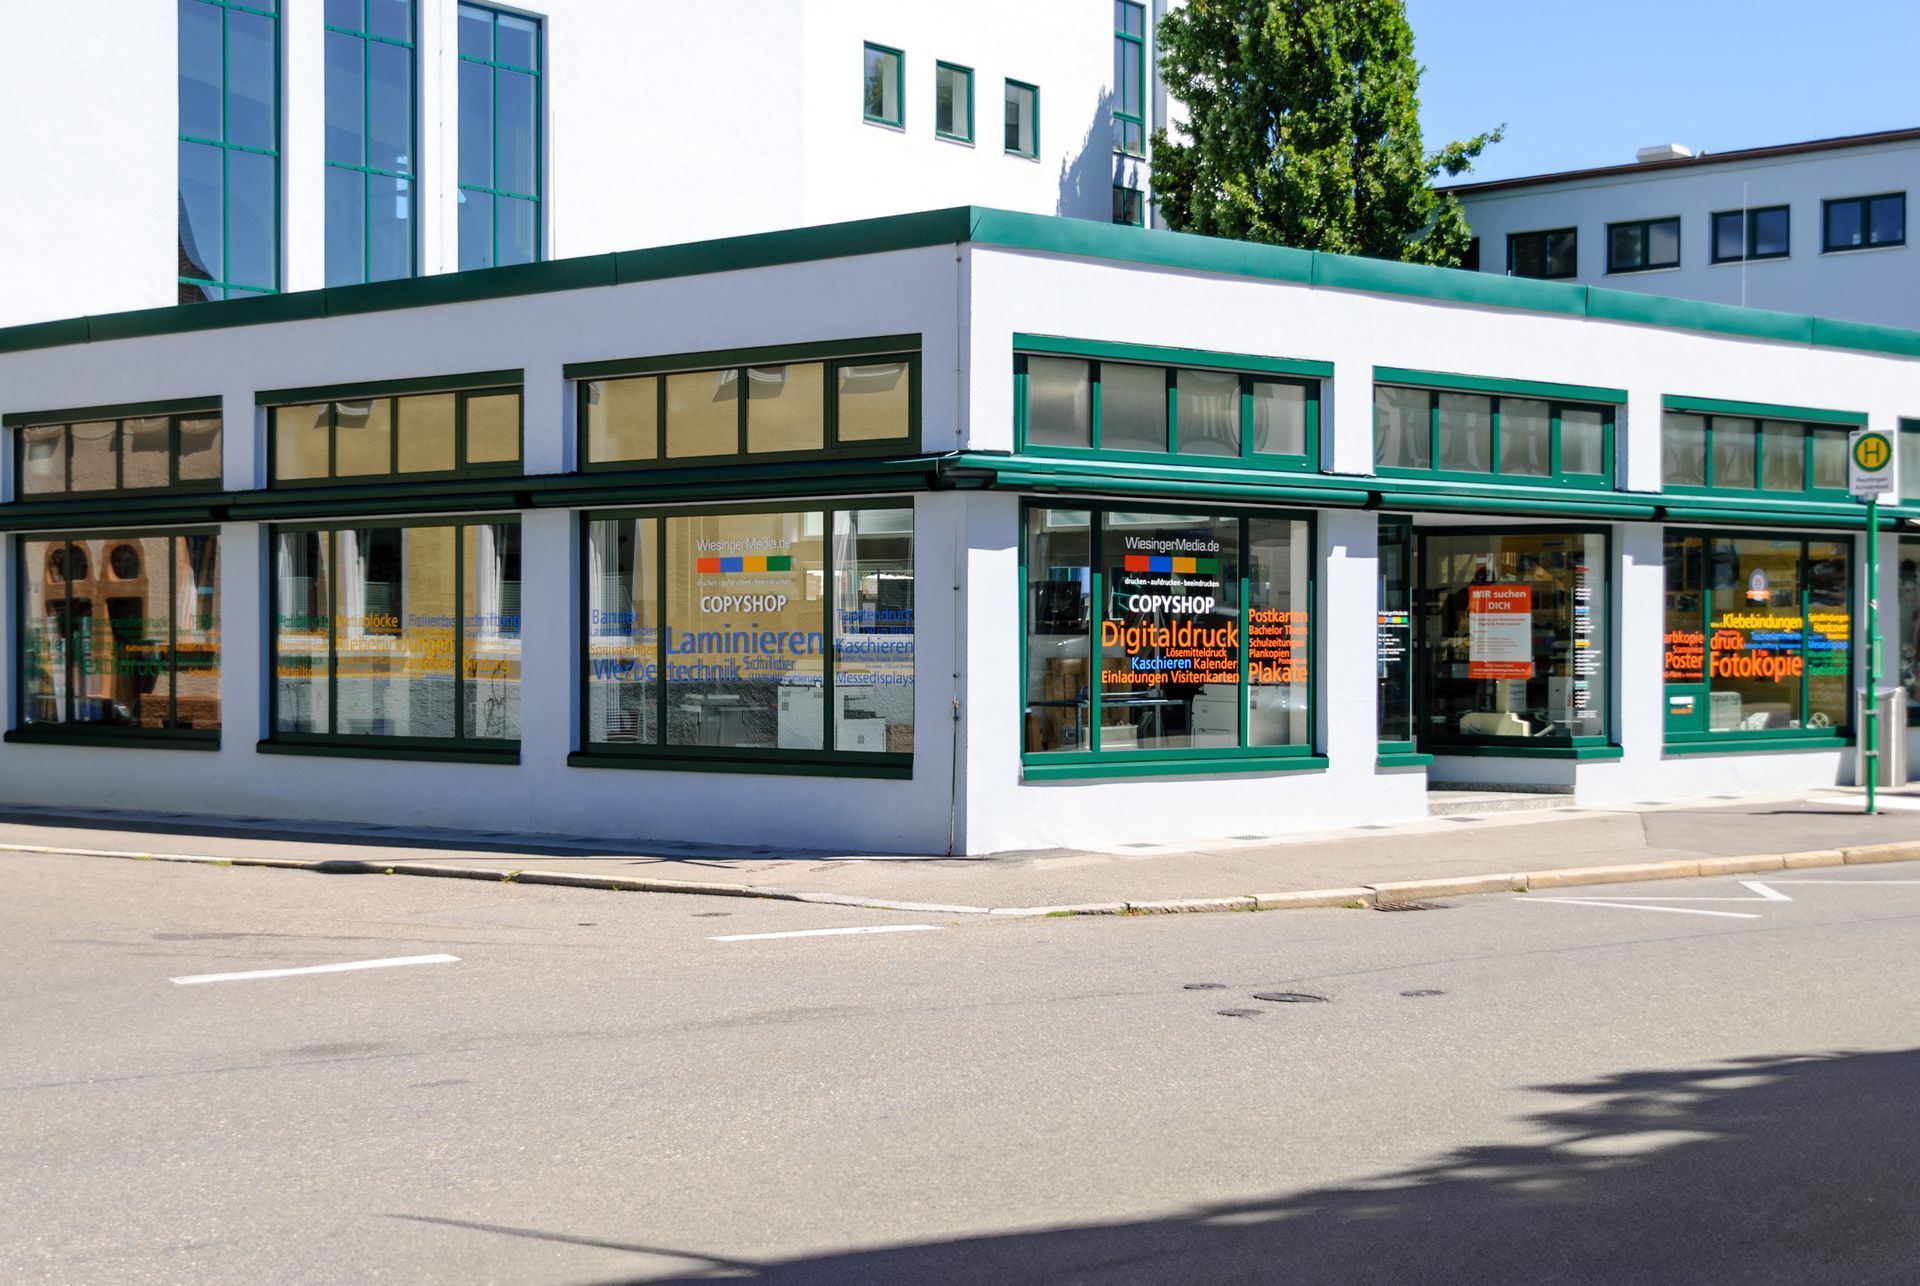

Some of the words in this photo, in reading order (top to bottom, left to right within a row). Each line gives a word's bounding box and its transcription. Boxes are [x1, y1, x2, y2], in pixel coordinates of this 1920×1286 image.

[697, 537, 791, 553] WiesingerMedia.de
[1125, 536, 1220, 553] WiesingerMedia.de
[1150, 579, 1181, 587] aufdrucken
[1472, 590, 1491, 598] WIR
[1494, 589, 1526, 598] suchen
[701, 595, 787, 613] COPYSHOP
[1128, 595, 1215, 614] COPYSHOP
[1488, 602, 1511, 610] DICH
[592, 609, 640, 625] Banner
[1248, 608, 1308, 623] Postkarten
[1722, 613, 1803, 632] Klebebindungen
[1101, 620, 1239, 654] Digitaldruck
[1248, 625, 1283, 635] Bachelor
[666, 623, 824, 656] Laminieren
[836, 637, 914, 654] Kaschieren
[1249, 637, 1304, 649] Schulzeitungen
[1663, 631, 1704, 646] arbkopie
[1710, 630, 1744, 650] druck
[1166, 647, 1227, 658] Lösemitteldruck
[1249, 648, 1290, 659] Plankopien
[1664, 651, 1704, 668] Poster
[742, 655, 796, 671] Schilder
[1131, 656, 1191, 670] Kaschieren
[1193, 657, 1237, 670] Kalender
[1248, 660, 1308, 682] Plakate
[1709, 649, 1803, 683] Fotokopie
[836, 671, 914, 687] Messedisplays
[1101, 670, 1168, 686] Einladungen
[1171, 670, 1240, 684] Visitenkarten
